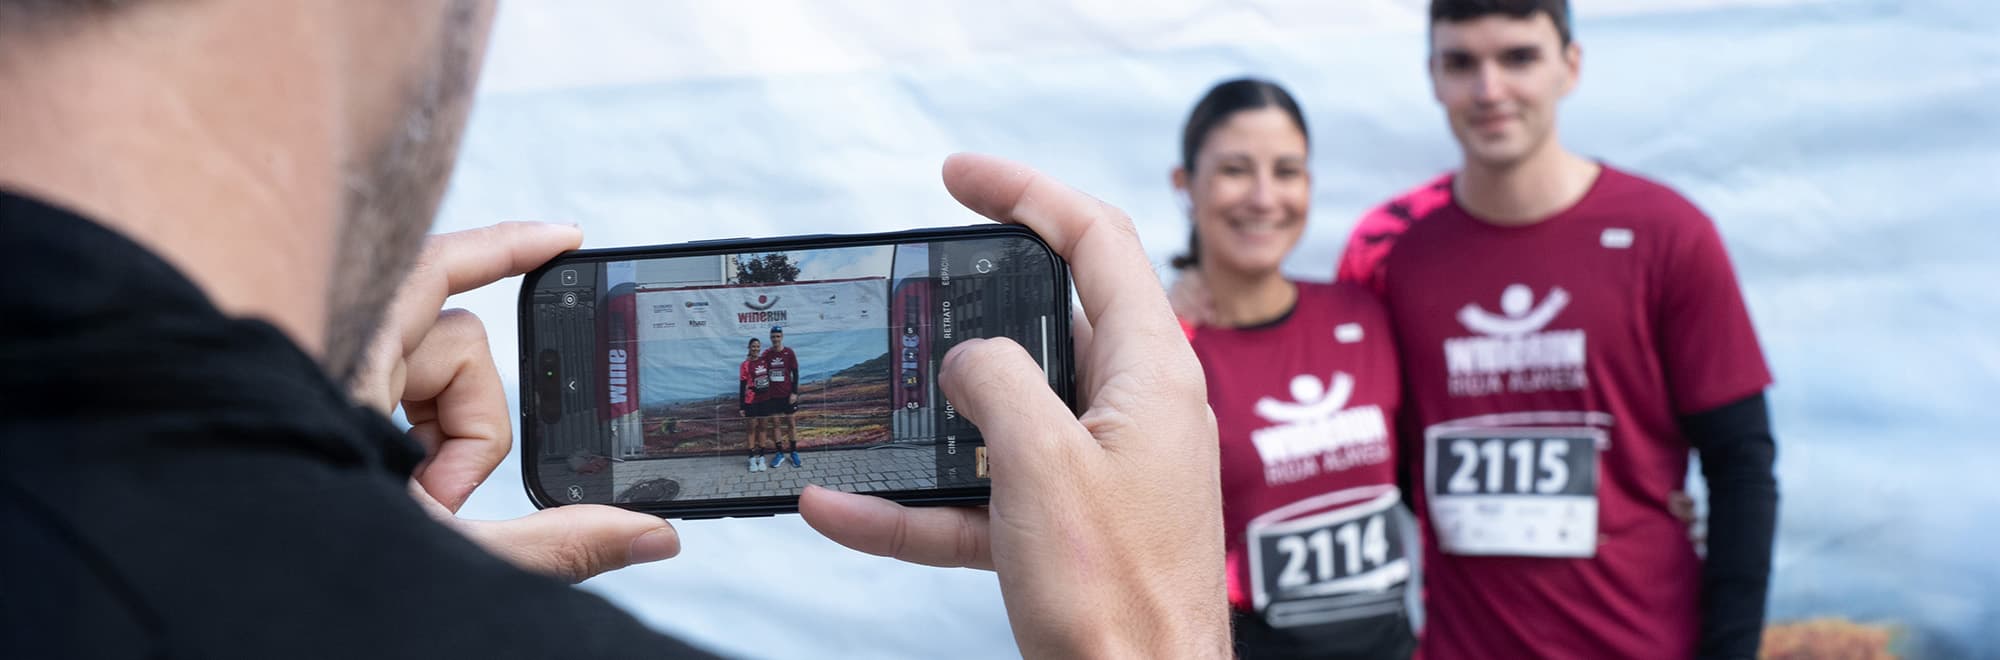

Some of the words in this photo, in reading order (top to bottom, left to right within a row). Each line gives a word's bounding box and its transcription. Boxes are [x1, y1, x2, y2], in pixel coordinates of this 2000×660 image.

[943, 301, 952, 339] RETRATO
[609, 349, 627, 404] wine
[947, 435, 956, 455] CINE
[1448, 439, 1569, 494] 2115
[1276, 514, 1389, 588] 2114
